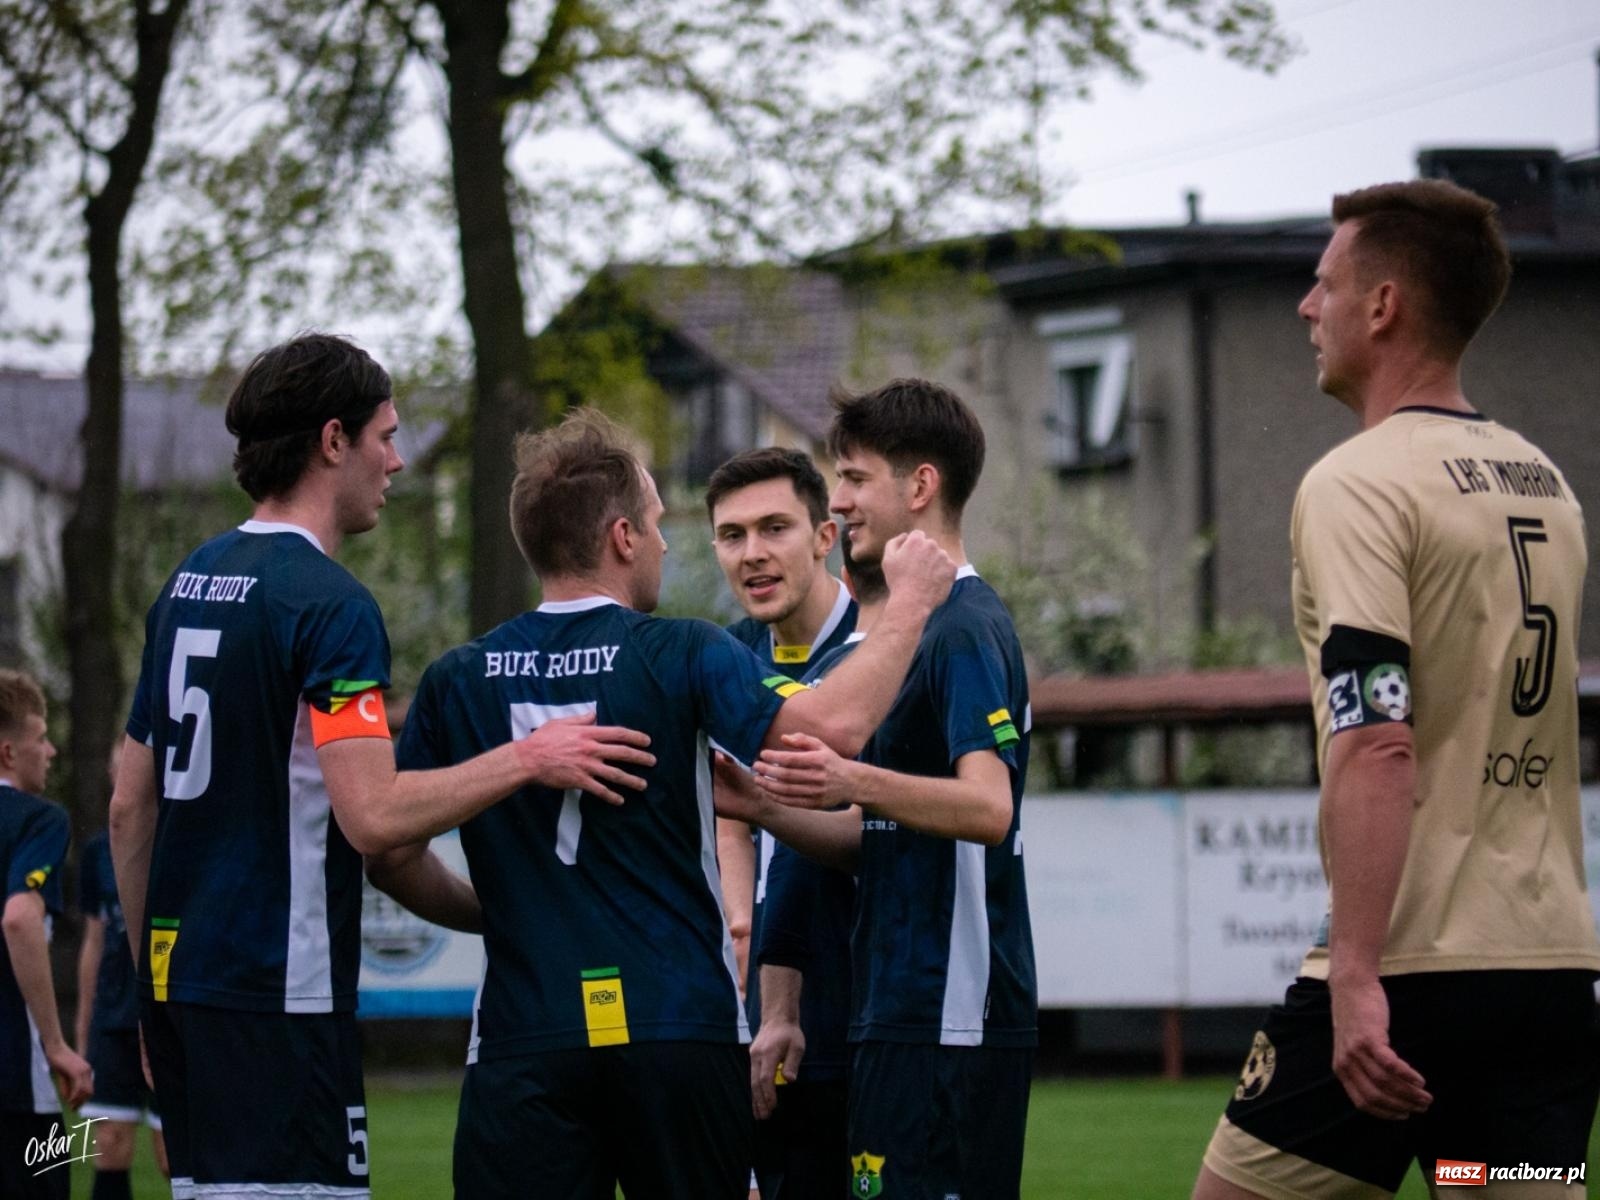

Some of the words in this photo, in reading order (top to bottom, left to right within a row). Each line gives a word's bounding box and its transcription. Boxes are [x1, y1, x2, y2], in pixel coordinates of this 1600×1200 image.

[170, 572, 204, 600] BUK
[205, 575, 258, 603] RUDY
[1507, 516, 1558, 717] 5
[485, 650, 540, 678] BUK
[545, 645, 620, 678] RUDY
[163, 627, 222, 801] 5
[358, 693, 379, 723] C
[510, 701, 598, 866] 7
[1194, 820, 1320, 852] KAMI
[346, 1106, 369, 1175] 5
